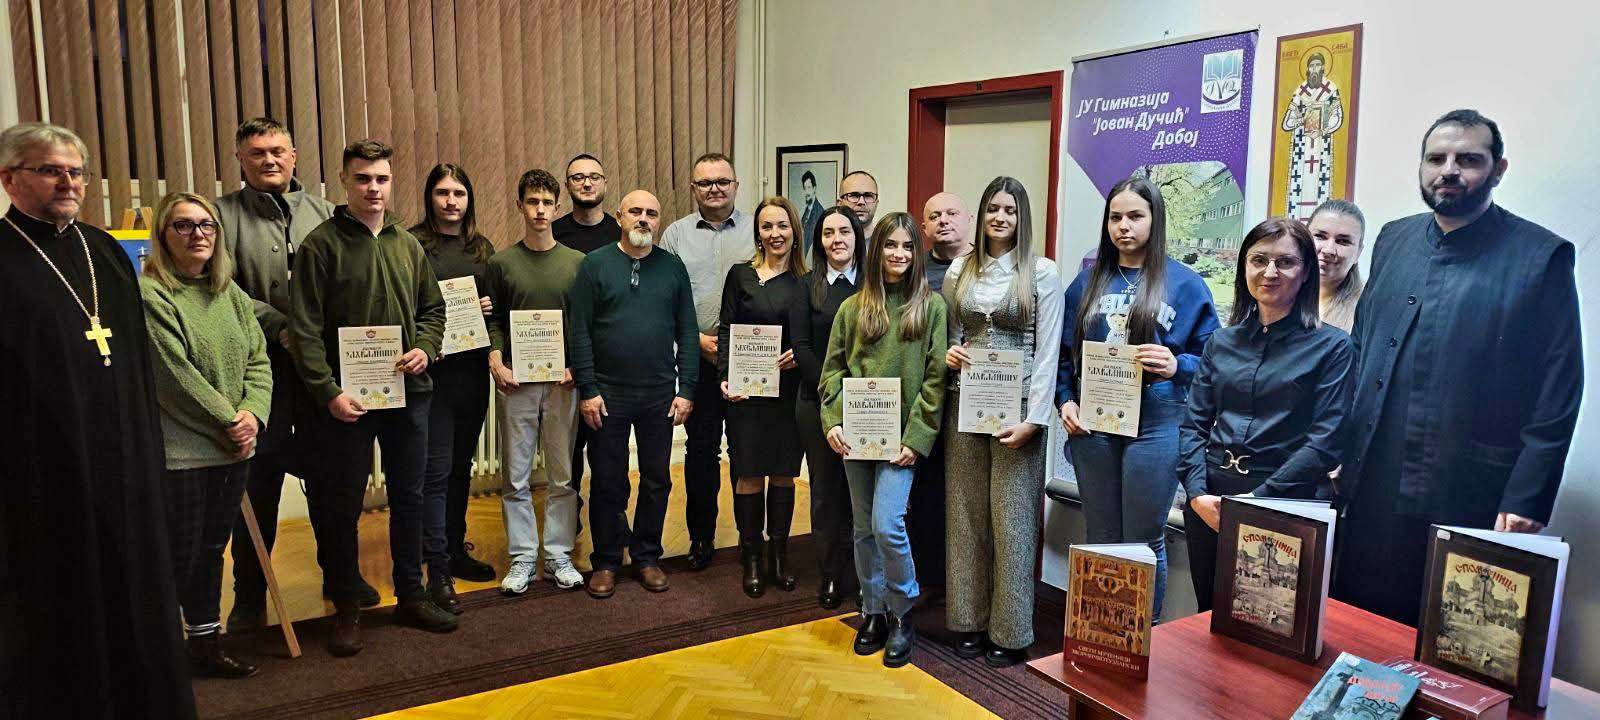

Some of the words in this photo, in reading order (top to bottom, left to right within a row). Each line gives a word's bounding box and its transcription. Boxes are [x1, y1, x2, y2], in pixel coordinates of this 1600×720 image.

[1075, 98, 1094, 118] ЈУ
[1094, 91, 1170, 113] Гимназија
[1092, 116, 1135, 136] "Јован
[1134, 106, 1190, 131] Дучић"
[1151, 128, 1200, 150] Добој
